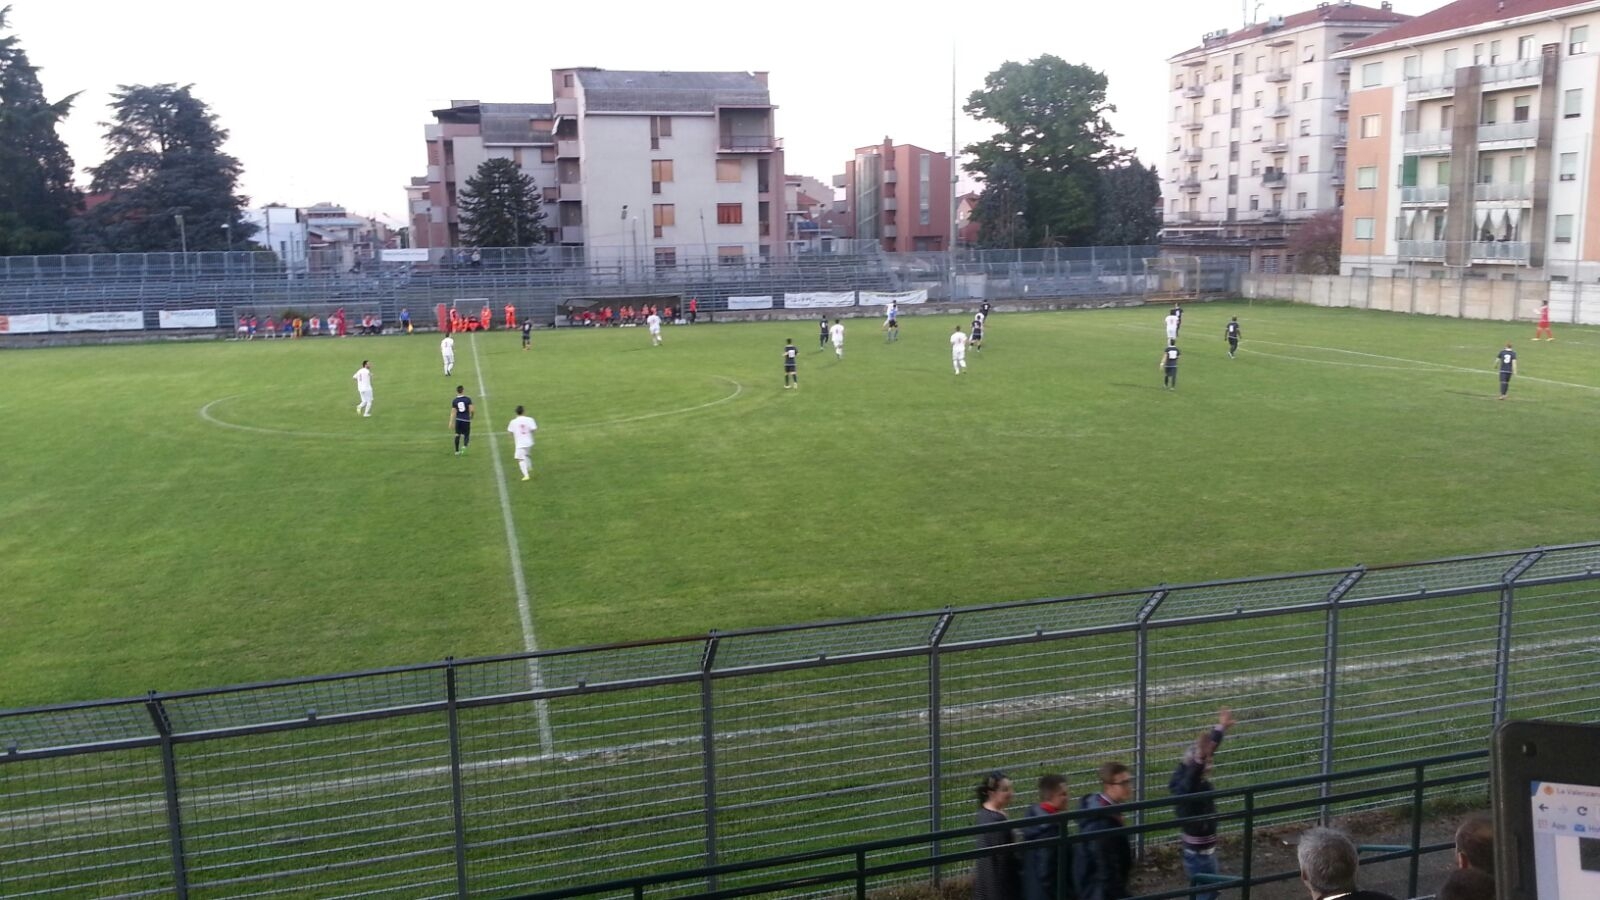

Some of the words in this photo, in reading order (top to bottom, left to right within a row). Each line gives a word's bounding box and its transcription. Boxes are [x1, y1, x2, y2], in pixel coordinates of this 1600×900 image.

[1503, 354, 1511, 364] 3
[457, 401, 466, 412] 9
[1551, 821, 1568, 831] App
